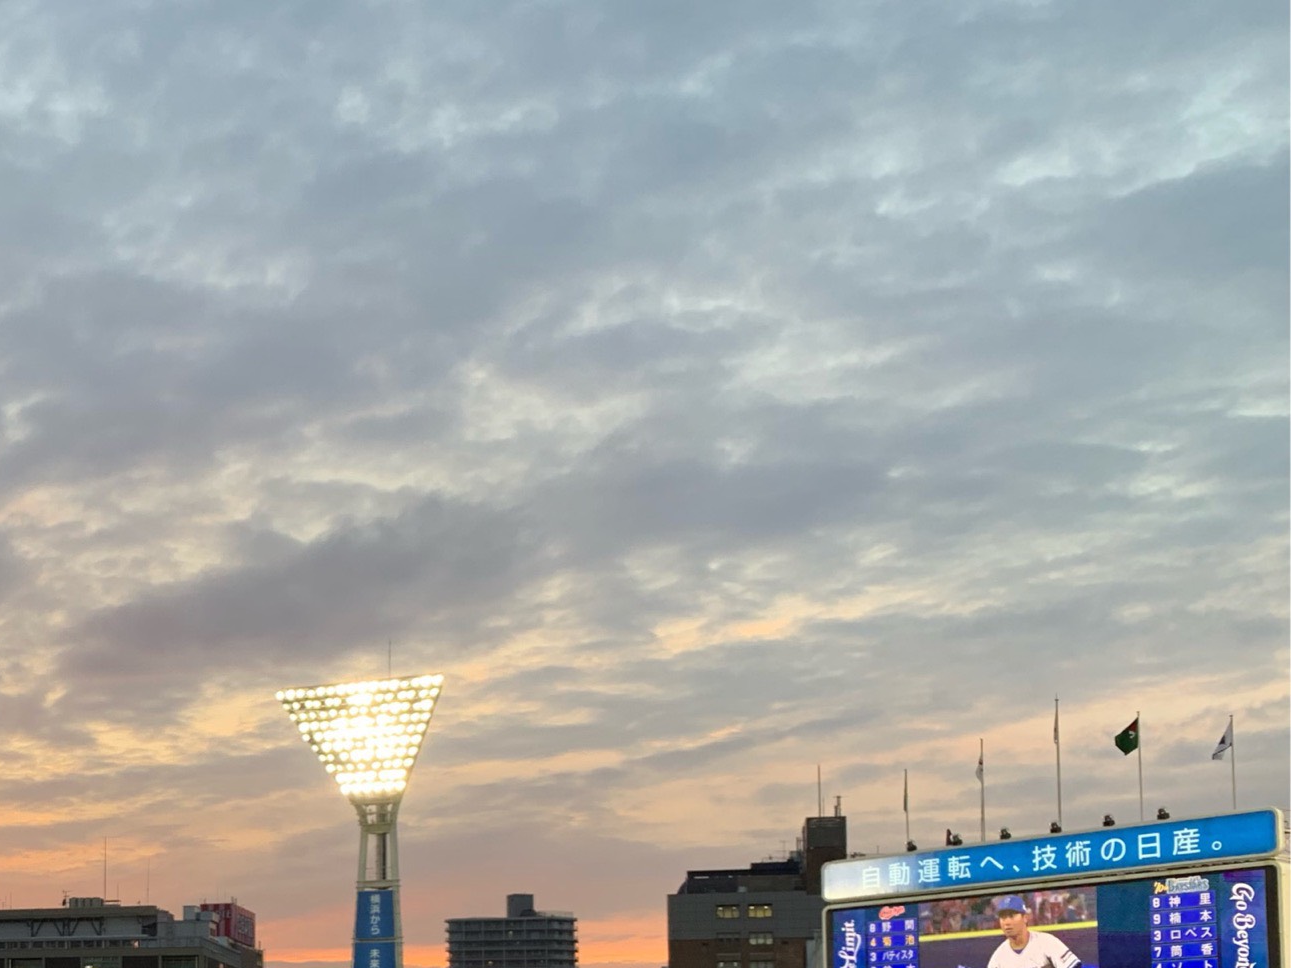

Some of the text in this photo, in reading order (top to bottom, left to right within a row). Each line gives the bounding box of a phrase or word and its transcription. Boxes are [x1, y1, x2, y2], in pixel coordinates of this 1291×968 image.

[861, 828, 1222, 889] 自動運転へ、技術の日産。
[1230, 882, 1255, 911] Go
[1152, 898, 1160, 908] 8
[1153, 914, 1160, 924] 9
[870, 922, 876, 933] 8
[1154, 926, 1212, 940] 3 ロペス
[870, 937, 876, 947] 4
[870, 952, 877, 962] 3
[1154, 946, 1161, 957] 7
